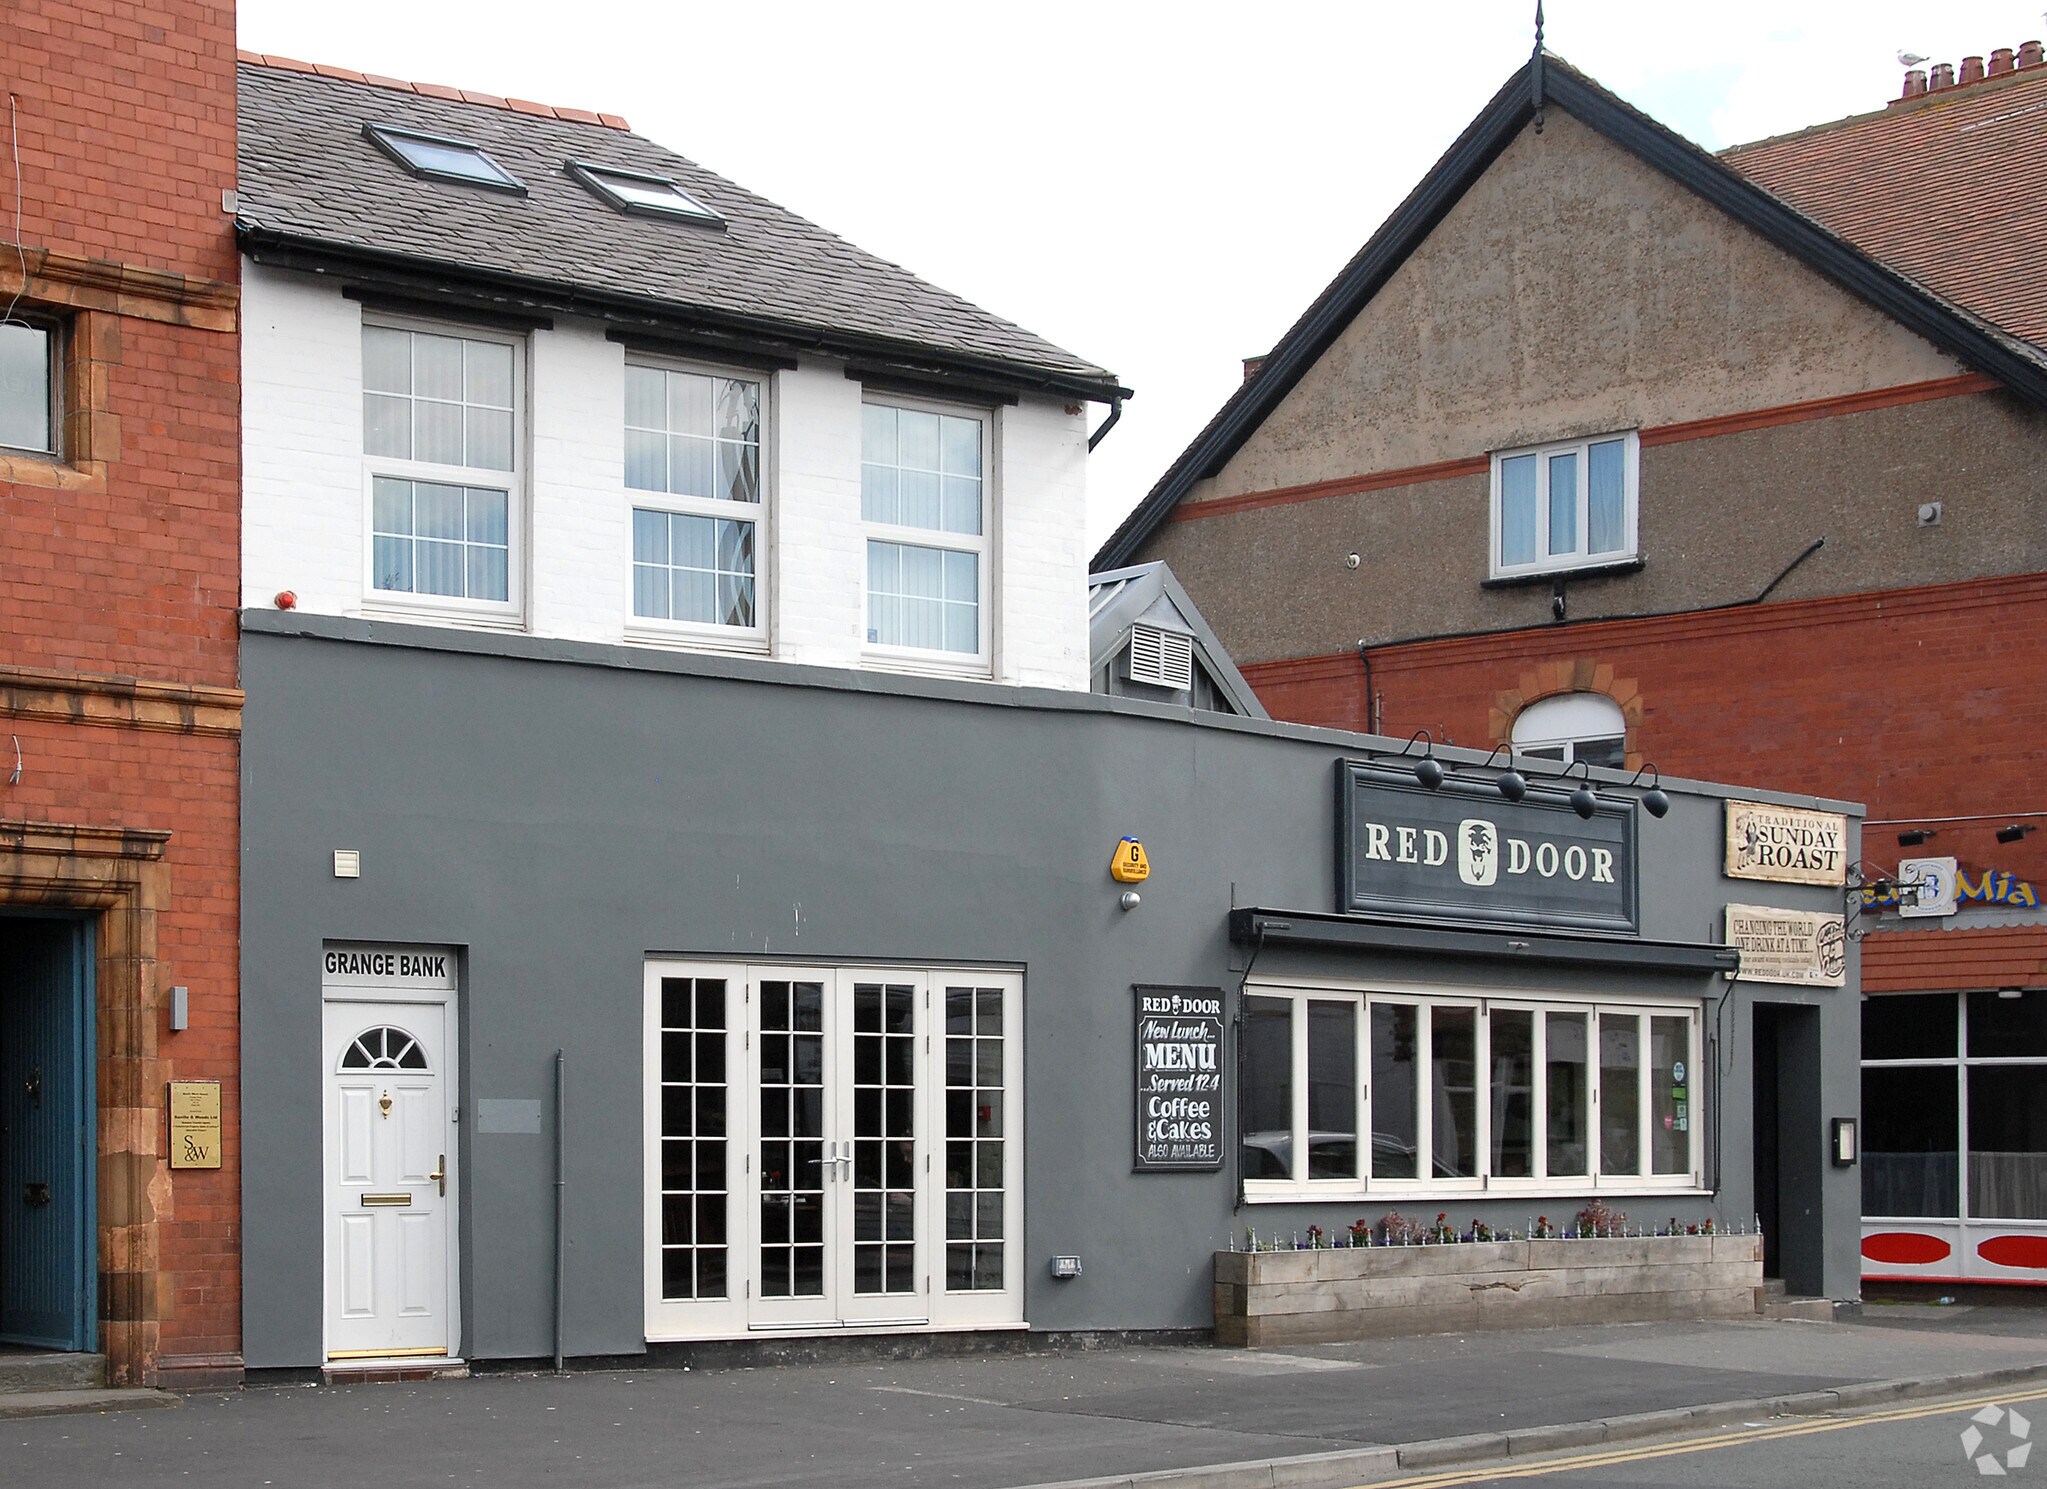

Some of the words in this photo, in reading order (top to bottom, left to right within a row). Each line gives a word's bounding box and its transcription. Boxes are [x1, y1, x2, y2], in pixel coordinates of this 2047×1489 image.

[1757, 815, 1839, 831] TRADITIONAL
[1758, 826, 1839, 849] SUNDAY
[1131, 845, 1139, 862] G
[1365, 822, 1448, 867] RED
[1507, 838, 1615, 884] DOOR
[1757, 845, 1839, 871] ROAST
[1955, 868, 2041, 909] Mia
[1733, 919, 1773, 936] CHANGING
[1787, 921, 1813, 937] WORLD
[325, 952, 394, 976] GRANGE
[400, 955, 446, 978] BANK
[1143, 997, 1170, 1012] RED
[1183, 999, 1220, 1014] DOOR
[1144, 1020, 1170, 1039] New
[1144, 1043, 1216, 1071] MENU
[1147, 1096, 1210, 1119] Coffee
[1148, 1144, 1169, 1158] ALSO
[1170, 1143, 1215, 1158] AVAILABLE
